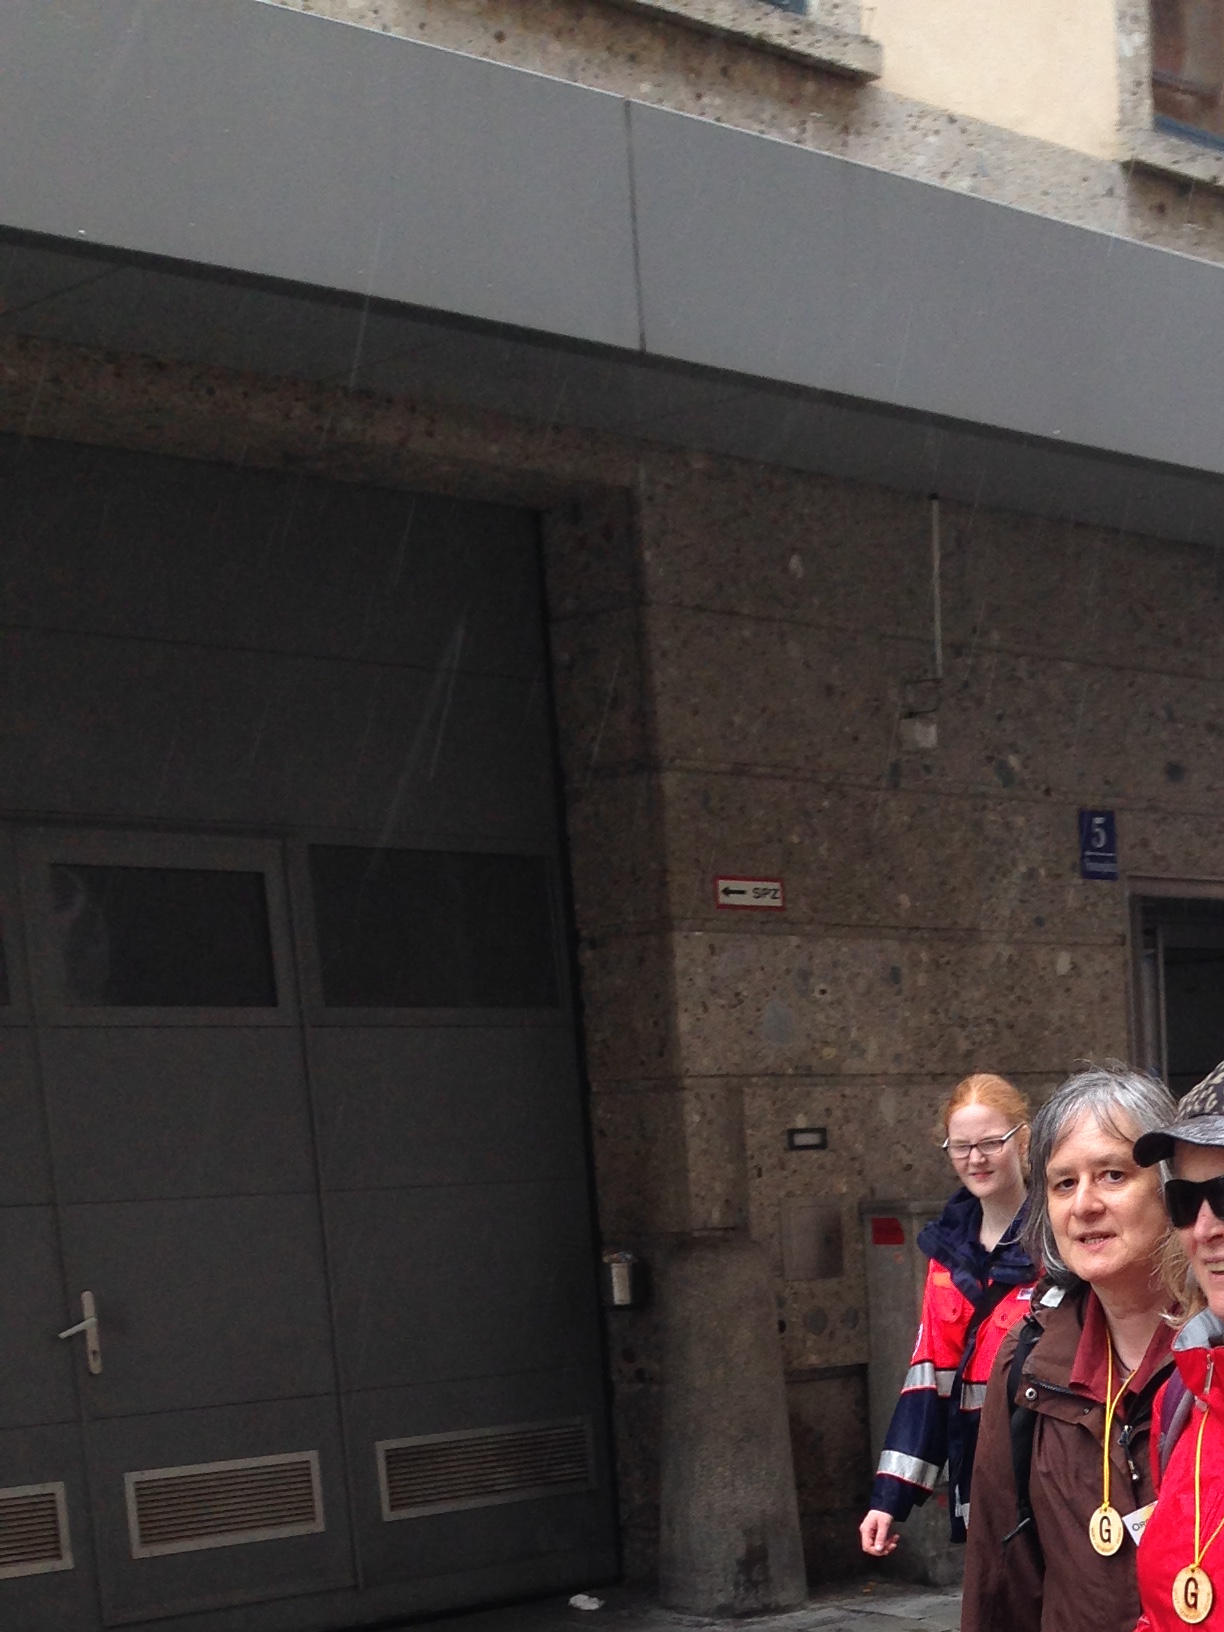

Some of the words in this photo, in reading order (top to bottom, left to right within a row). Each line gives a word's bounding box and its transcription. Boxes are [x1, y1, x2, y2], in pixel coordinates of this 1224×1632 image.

[1091, 817, 1107, 848] 5
[752, 887, 780, 899] SPZ
[1099, 1515, 1112, 1543] G
[1184, 1577, 1199, 1609] G
